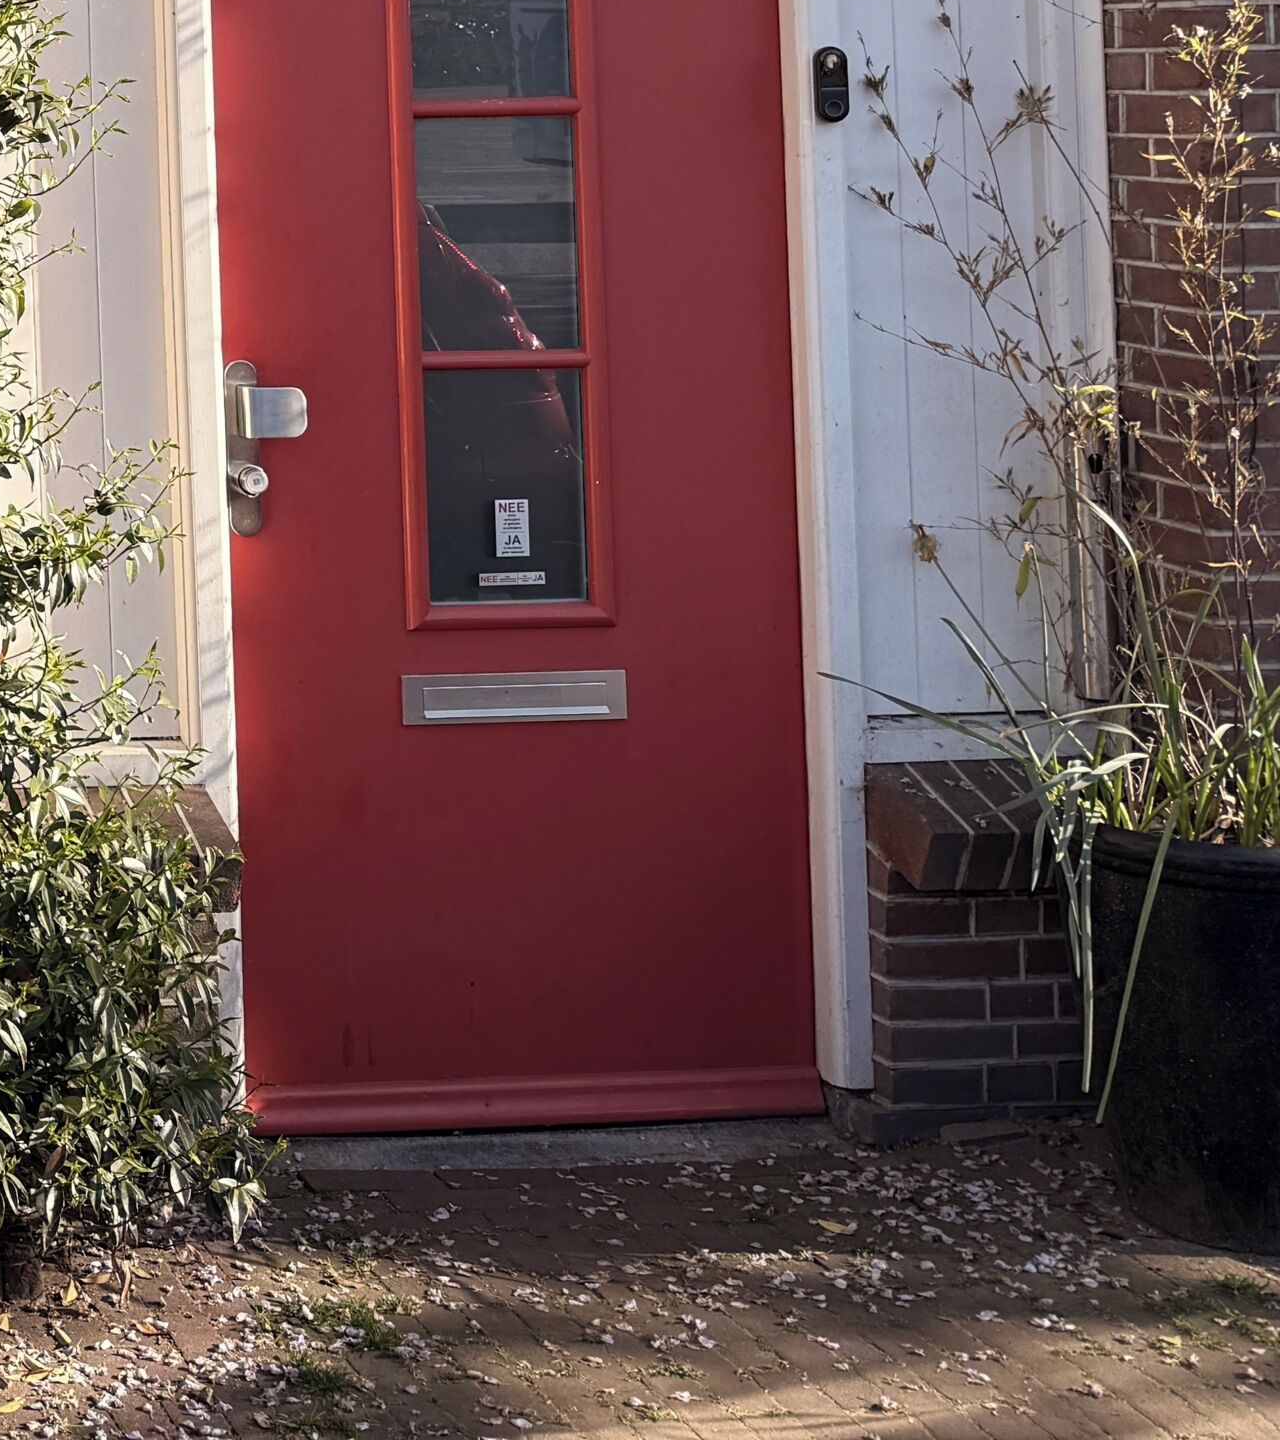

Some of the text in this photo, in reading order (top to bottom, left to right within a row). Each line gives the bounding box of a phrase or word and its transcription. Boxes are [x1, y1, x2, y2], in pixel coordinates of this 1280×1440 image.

[498, 502, 525, 513] NEE
[504, 535, 521, 545] JA
[532, 574, 543, 582] JA
